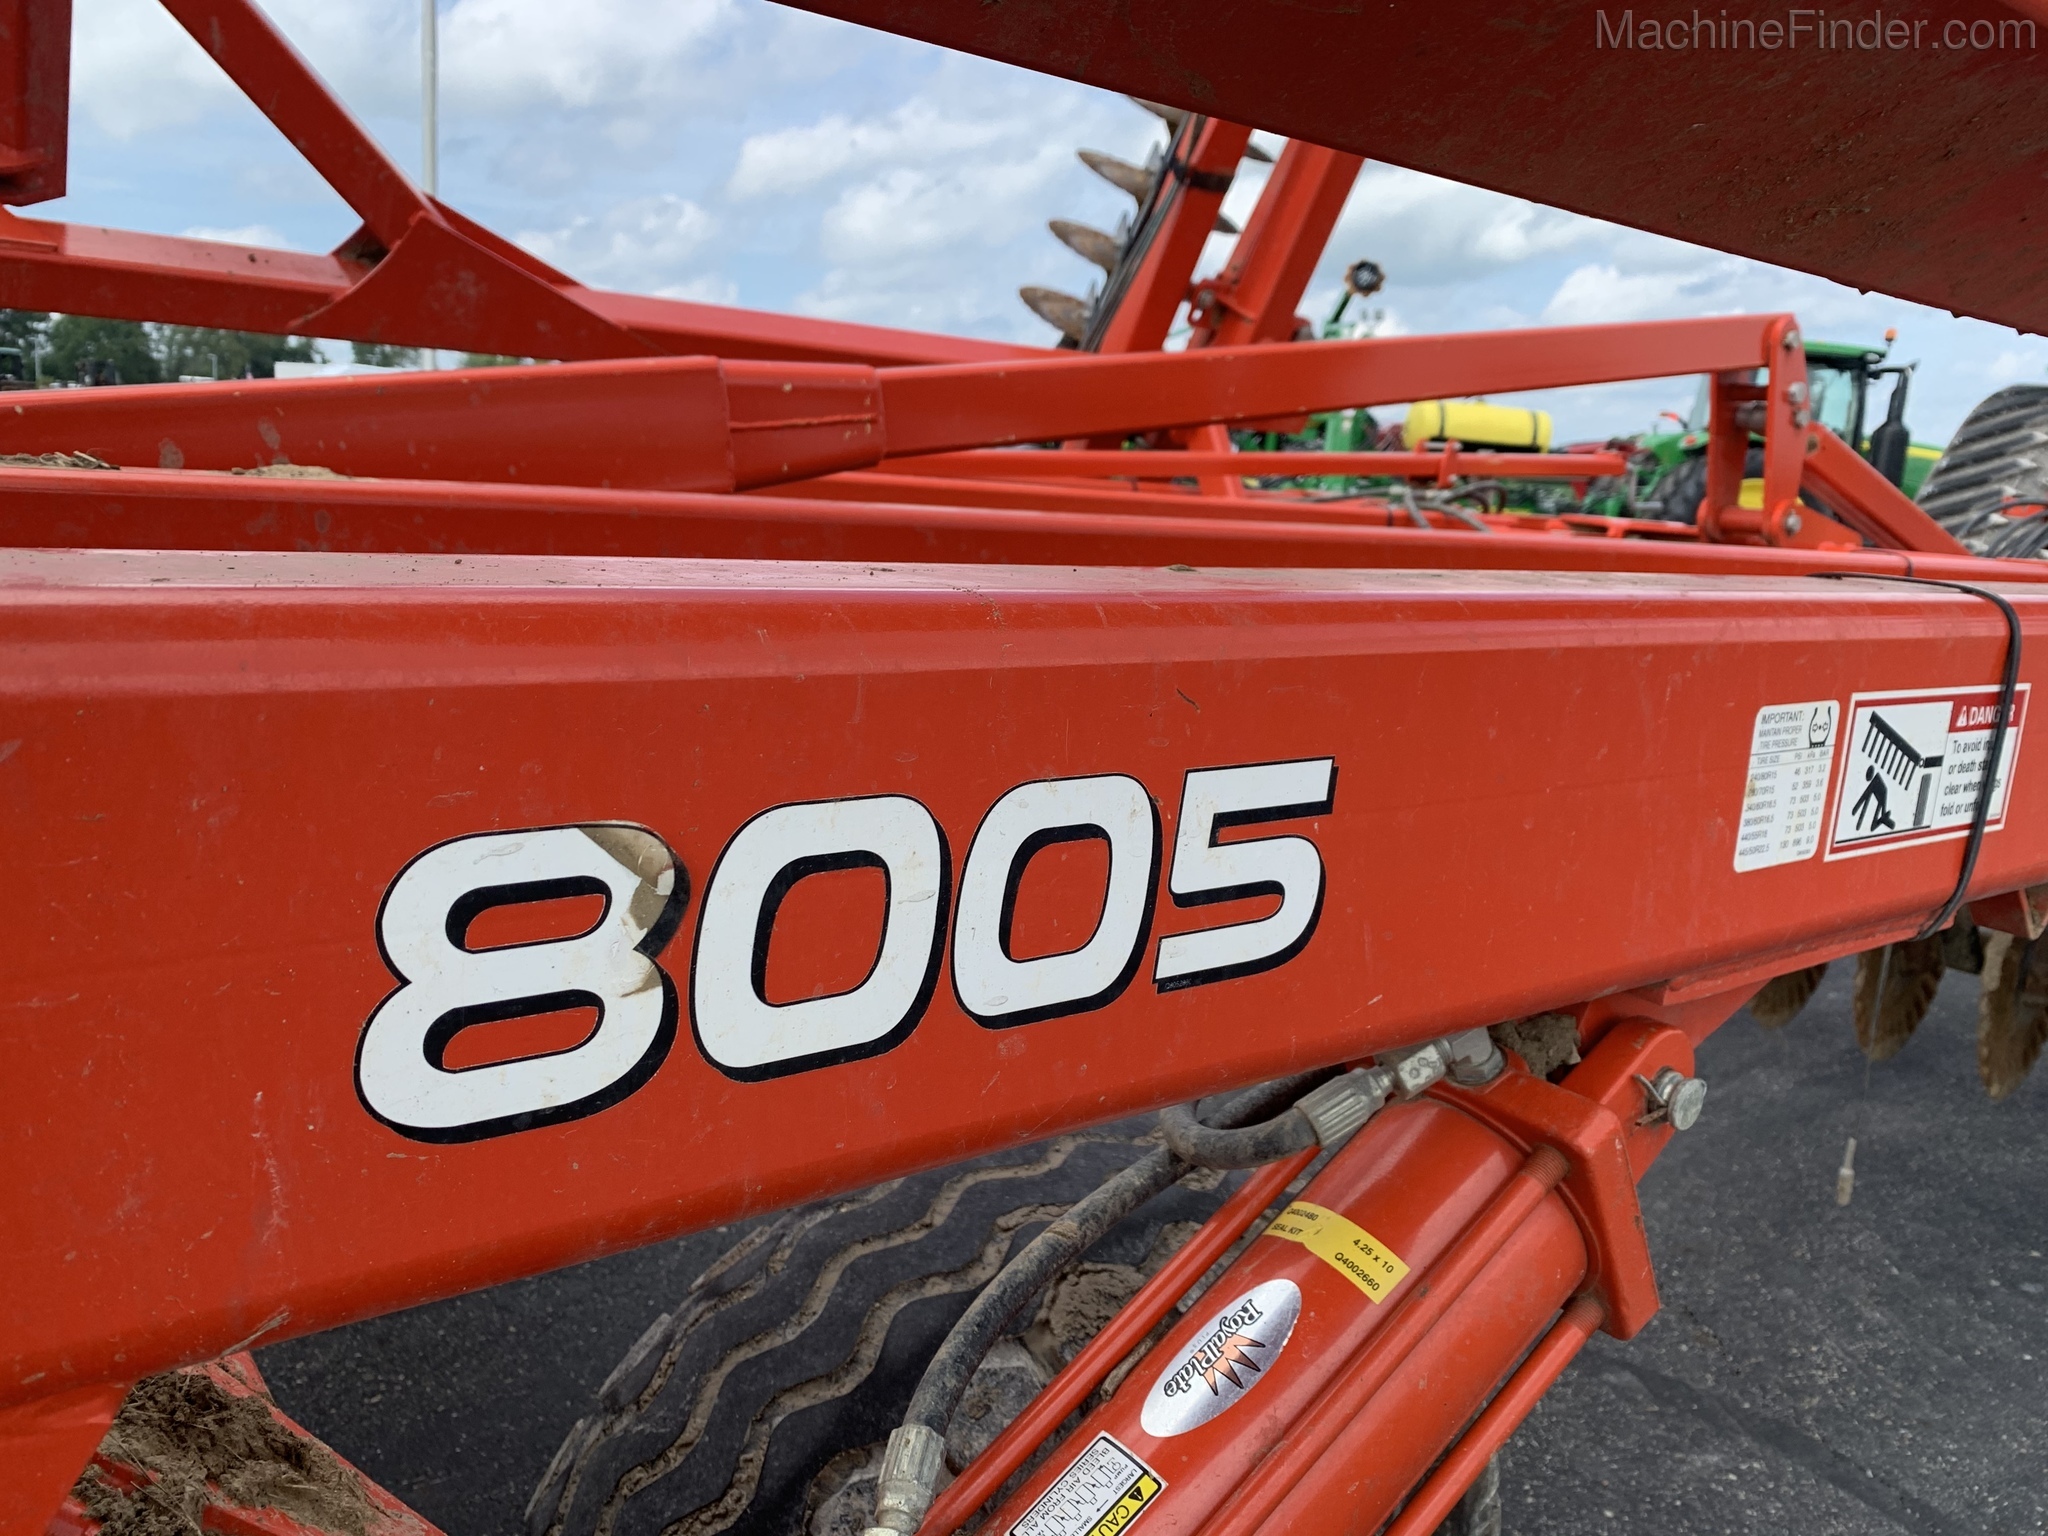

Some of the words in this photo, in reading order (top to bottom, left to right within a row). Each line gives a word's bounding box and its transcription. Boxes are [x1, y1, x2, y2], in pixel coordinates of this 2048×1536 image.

[1761, 710, 1805, 725] IMPORTANT:
[1759, 740, 1771, 750] TIRE
[1953, 740, 1962, 754] To
[1962, 737, 1981, 753] avoid
[1757, 756, 1769, 765] TIRE
[1769, 755, 1781, 764] SIZE
[1948, 764, 1958, 775] or
[1957, 759, 1976, 774] death
[1944, 782, 1962, 797] clear
[1963, 778, 1981, 794] when
[1940, 802, 1954, 817] fold
[1955, 803, 1964, 814] or
[354, 756, 1336, 1145] 8005
[1271, 1222, 1287, 1232] SEAL
[1288, 1225, 1304, 1236] KIT
[1352, 1238, 1374, 1256] 4.25
[1372, 1254, 1381, 1263] x
[1381, 1261, 1394, 1274] 10
[1334, 1252, 1381, 1292] Q4002660
[1069, 1448, 1099, 1479] SERIES
[1083, 1447, 1110, 1476] BLEED
[1113, 1464, 1129, 1480] PUMP
[1113, 1468, 1138, 1494] LARGEST
[1066, 1475, 1082, 1493] AIR
[1021, 1479, 1069, 1529] CYLINDERS
[1040, 1493, 1066, 1521] FROM
